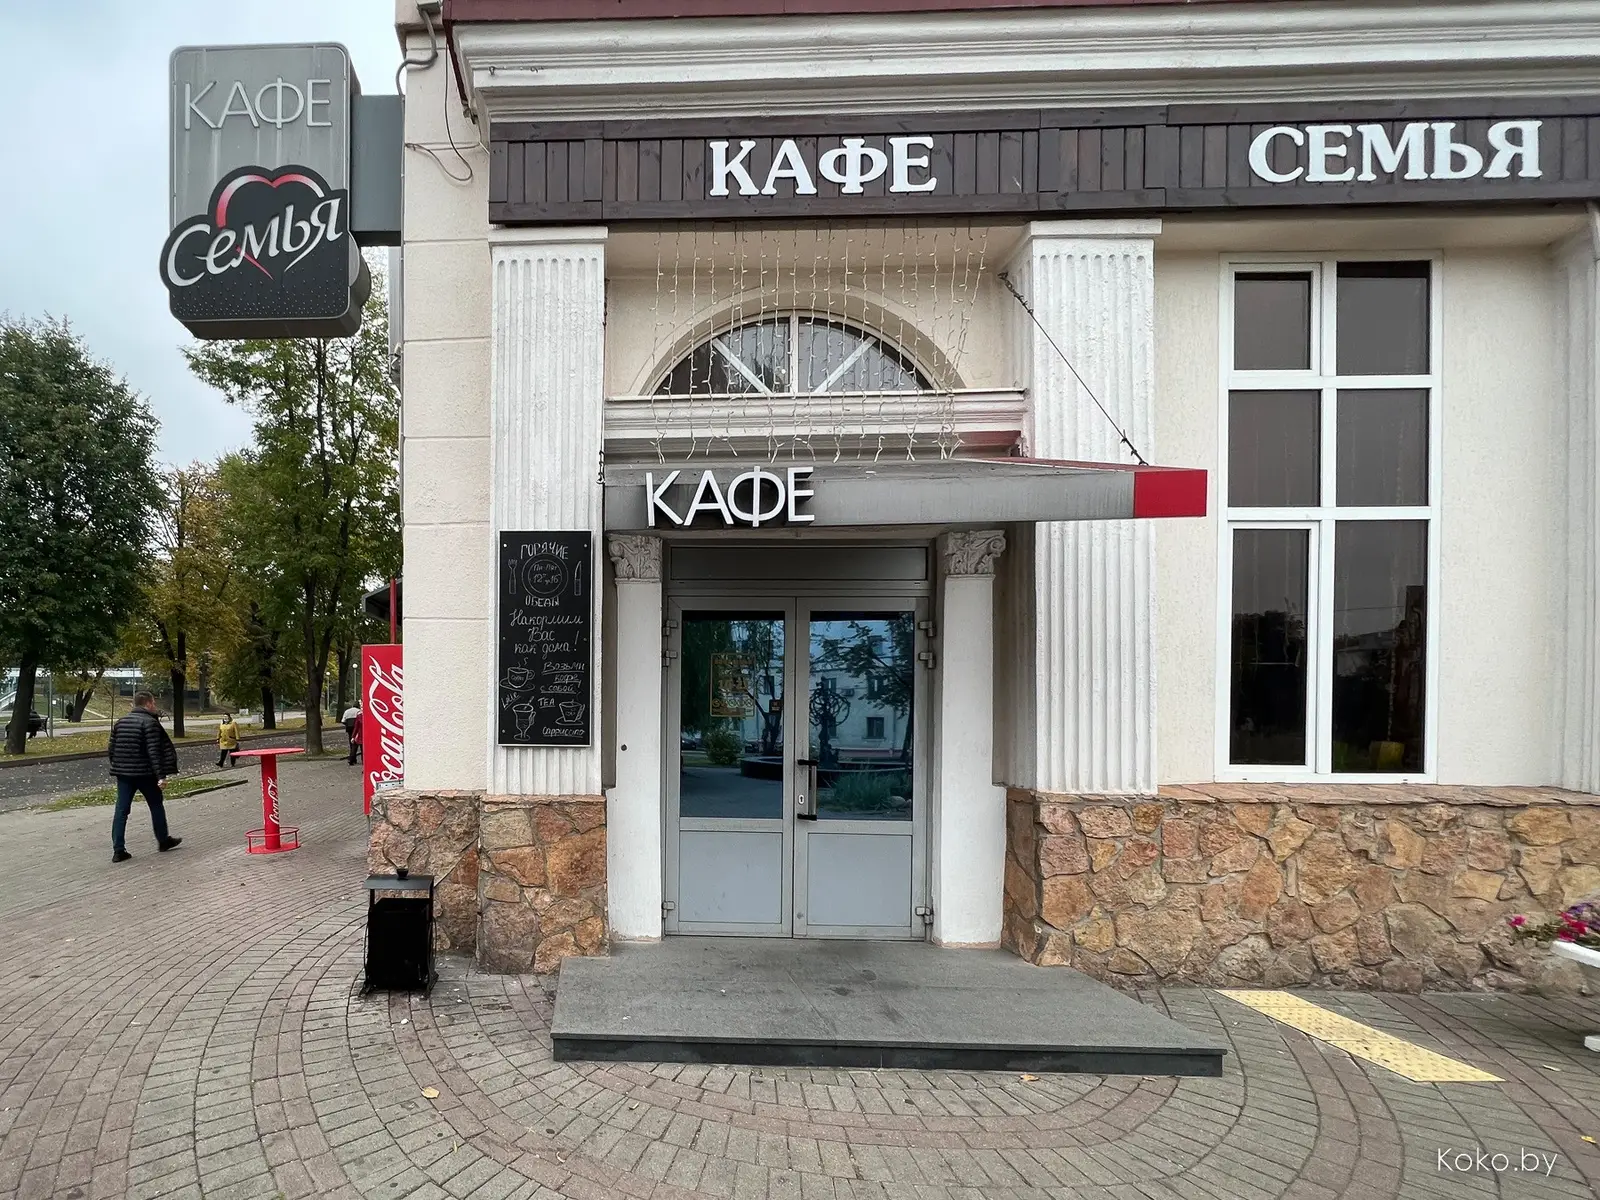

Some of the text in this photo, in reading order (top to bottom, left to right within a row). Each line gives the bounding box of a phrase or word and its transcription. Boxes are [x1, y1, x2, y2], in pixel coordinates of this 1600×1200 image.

[184, 77, 332, 130] КАФЕ
[709, 120, 1543, 196] КАФЕ СЕМЬЯ
[167, 198, 343, 287] Семья
[645, 466, 815, 528] КАФЕ
[520, 541, 569, 560] ГОРЯЧИЕ
[525, 595, 560, 607] ОБЕДЫ
[509, 609, 584, 631] Накормим
[528, 626, 555, 642] Вас
[514, 643, 537, 654] как
